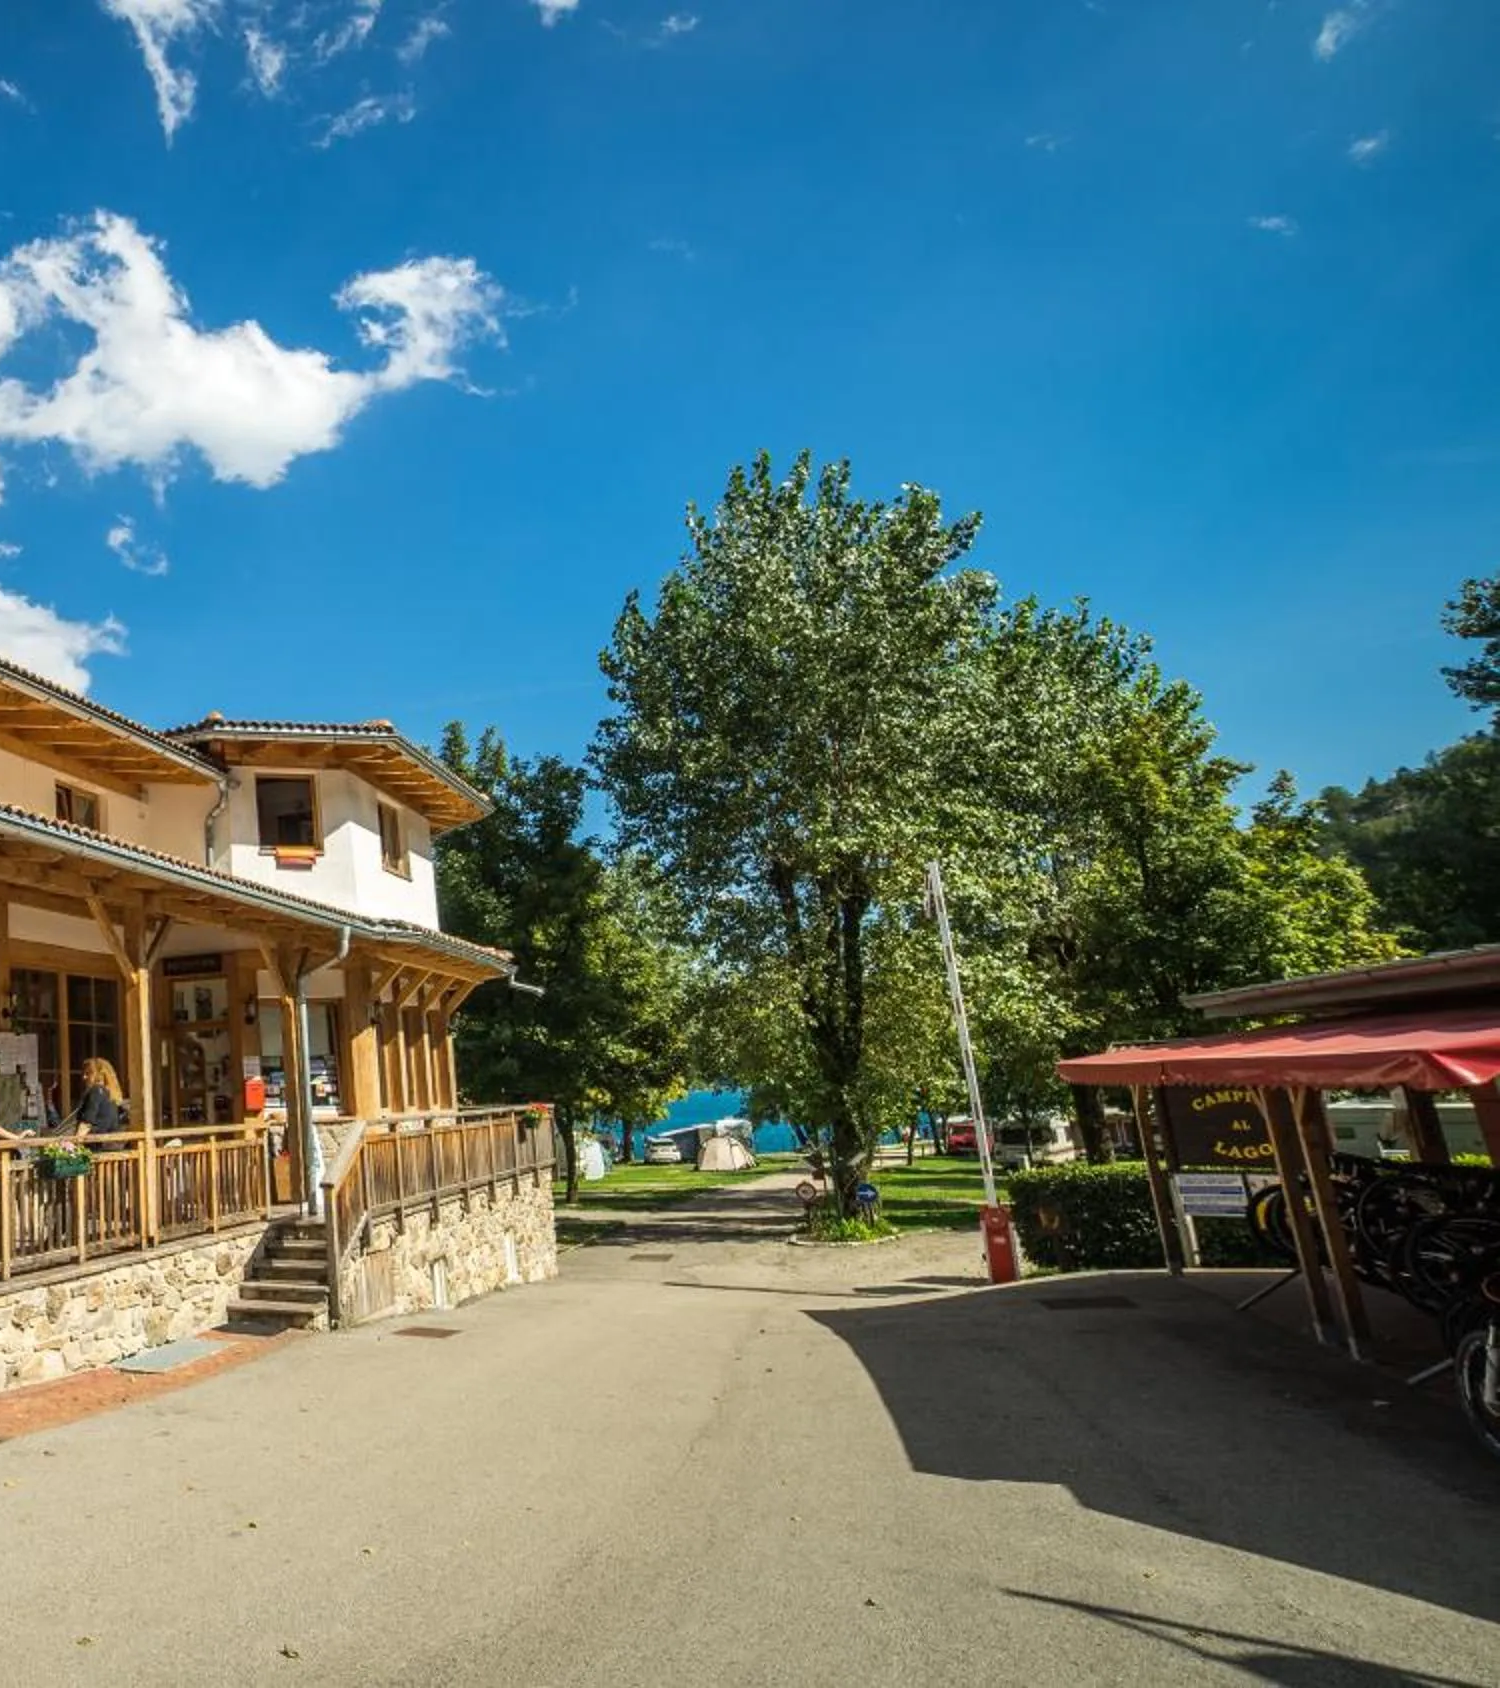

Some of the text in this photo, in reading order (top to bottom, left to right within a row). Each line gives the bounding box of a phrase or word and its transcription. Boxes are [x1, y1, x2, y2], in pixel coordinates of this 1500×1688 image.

[1192, 1089, 1256, 1112] CAMPI
[1232, 1119, 1252, 1131] AL
[1214, 1140, 1274, 1159] LAGO
